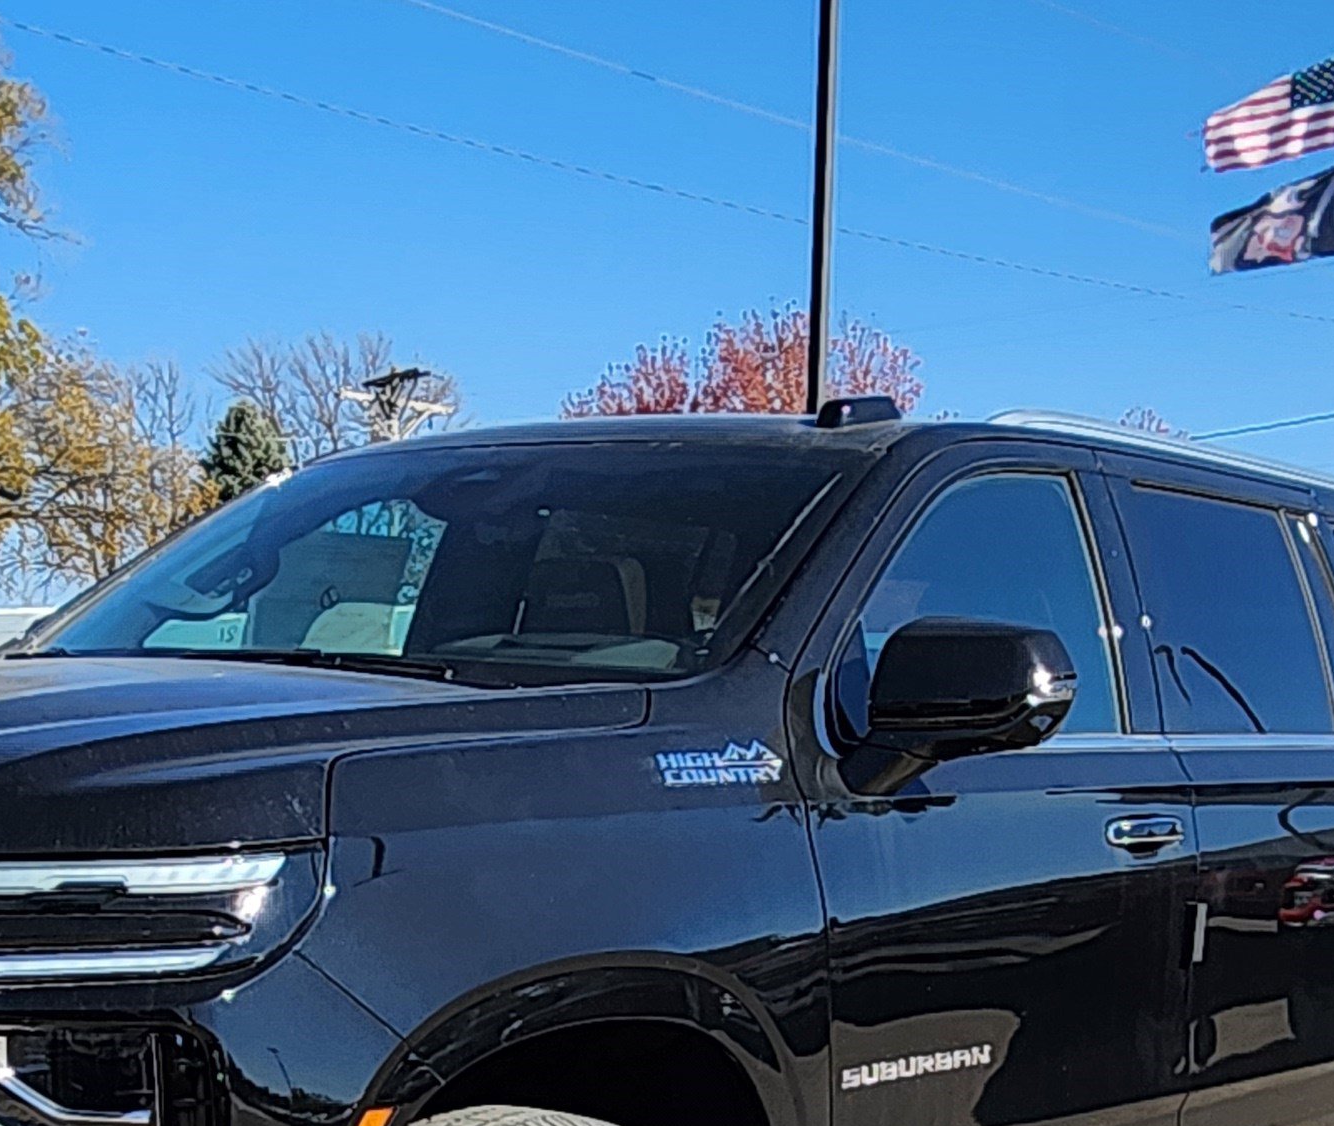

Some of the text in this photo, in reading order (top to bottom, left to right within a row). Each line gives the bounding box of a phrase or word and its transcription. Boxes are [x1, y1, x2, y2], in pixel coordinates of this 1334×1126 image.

[655, 752, 724, 770] HIGH
[664, 764, 783, 785] COUNTRY
[841, 1044, 992, 1090] SUBURBAN
